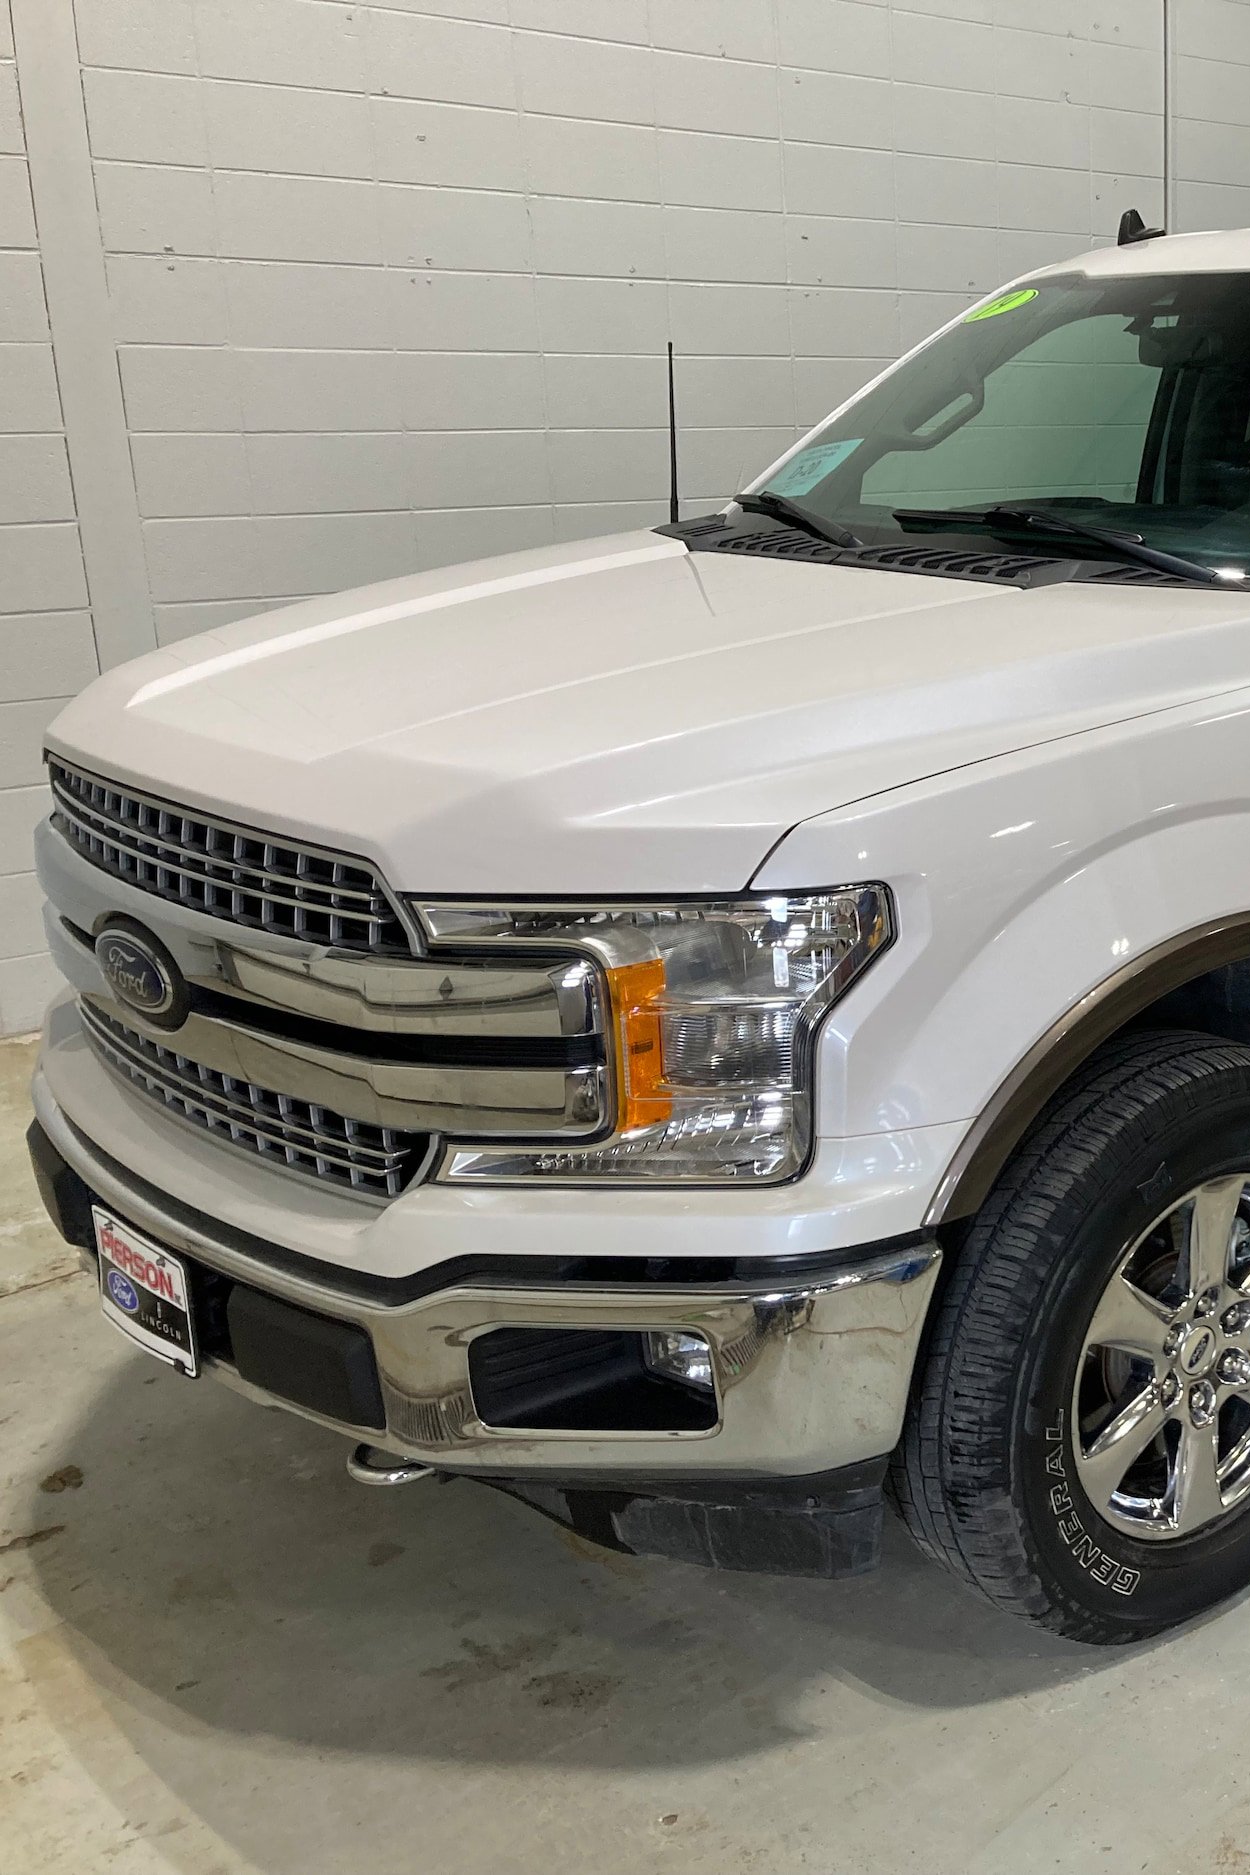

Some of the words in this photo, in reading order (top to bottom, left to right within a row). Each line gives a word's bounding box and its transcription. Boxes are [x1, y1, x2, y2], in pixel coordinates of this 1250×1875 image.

[106, 946, 149, 998] Ford
[98, 1225, 177, 1300] PIERSON
[140, 1310, 182, 1341] LINCOLN
[1045, 1408, 1141, 1597] GENERAL
